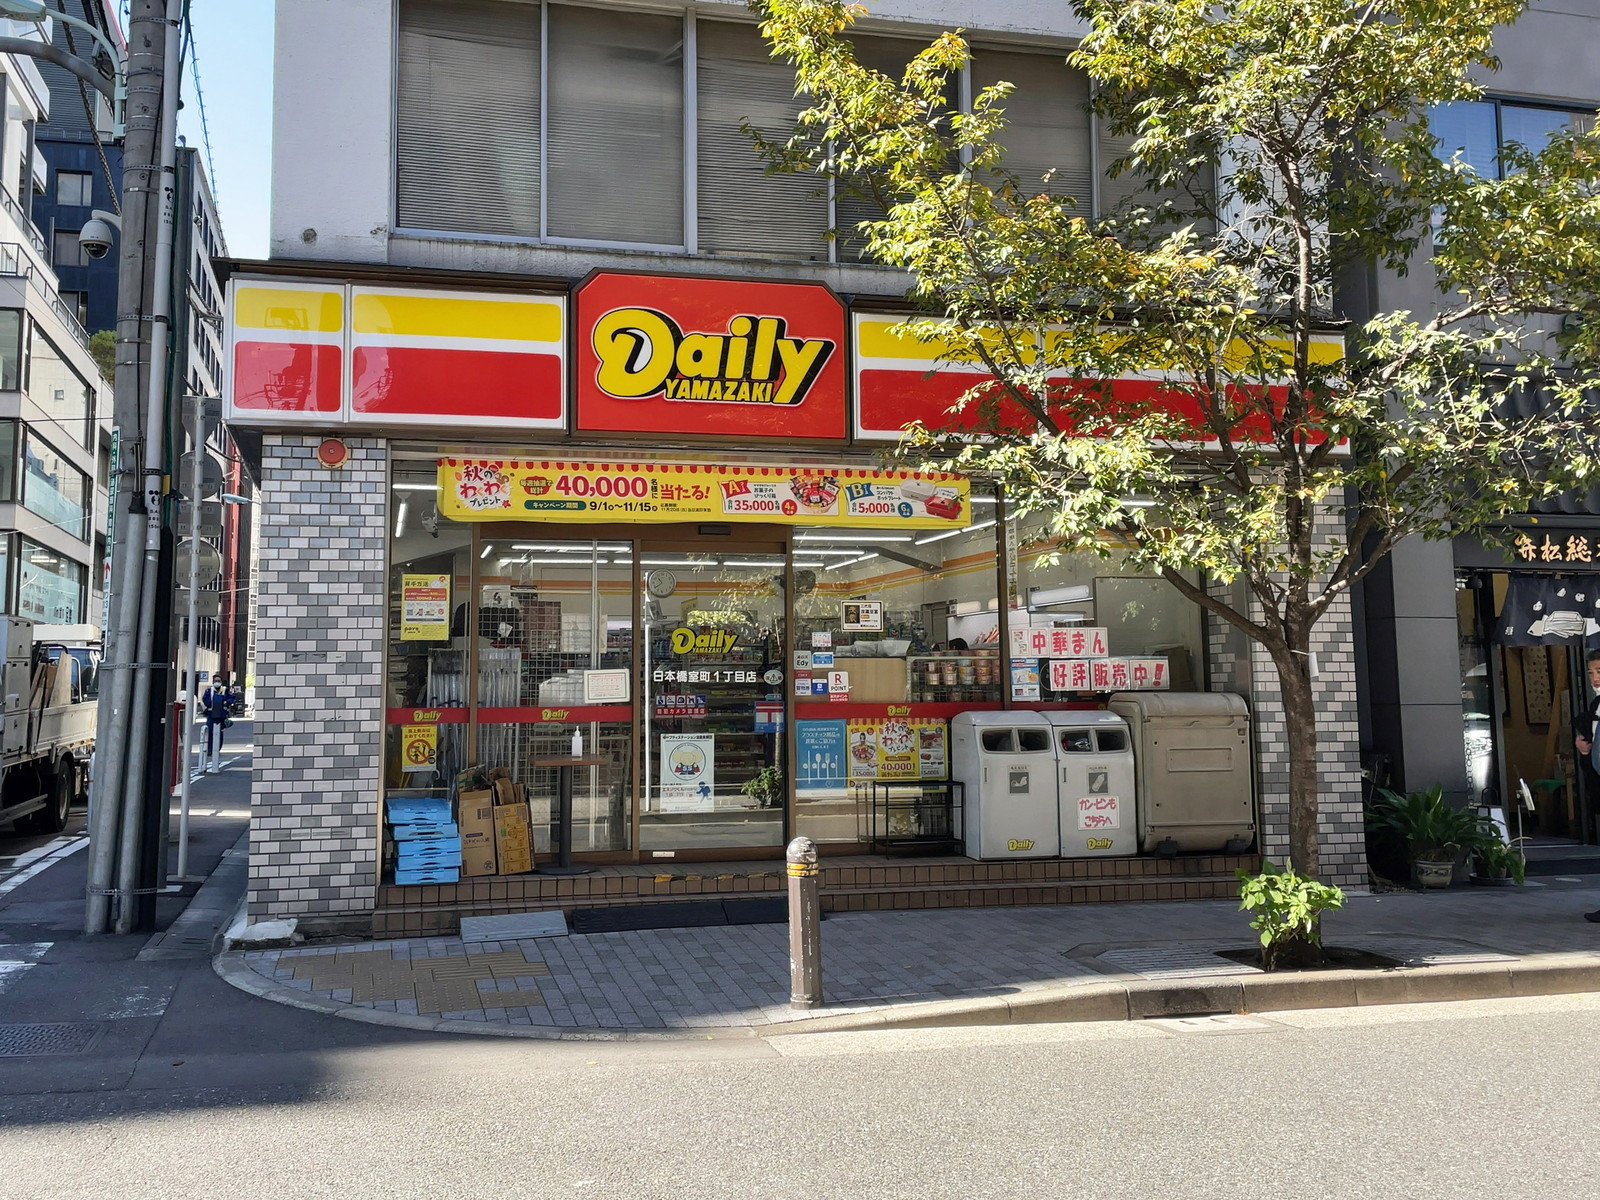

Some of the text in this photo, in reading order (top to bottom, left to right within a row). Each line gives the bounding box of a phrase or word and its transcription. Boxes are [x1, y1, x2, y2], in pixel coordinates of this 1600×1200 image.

[592, 307, 836, 405] Daily
[665, 378, 774, 403] YAMAZAKI
[463, 465, 493, 481] 秋の
[460, 481, 507, 498] わくわく
[556, 475, 648, 498] 40,000
[660, 483, 711, 501] 当たる!
[729, 480, 740, 495] A
[851, 483, 863, 498] B
[470, 496, 501, 507] プレゼント
[734, 500, 774, 511] 35,000
[858, 503, 890, 513] 5,000
[671, 627, 740, 654] Daily
[1032, 631, 1105, 655] 中華まん
[653, 670, 757, 682] 日本橋室町1丁目店
[834, 673, 842, 684] R
[1053, 663, 1164, 688] 好評販売中!
[413, 710, 441, 722] Daily
[542, 709, 569, 721] Daily
[887, 705, 912, 717] Daily
[884, 723, 904, 735] 秋の
[881, 763, 912, 771] 40,000
[1084, 815, 1113, 828] こちらへ
[1008, 839, 1035, 851] Daily
[1087, 838, 1113, 850] Daily
